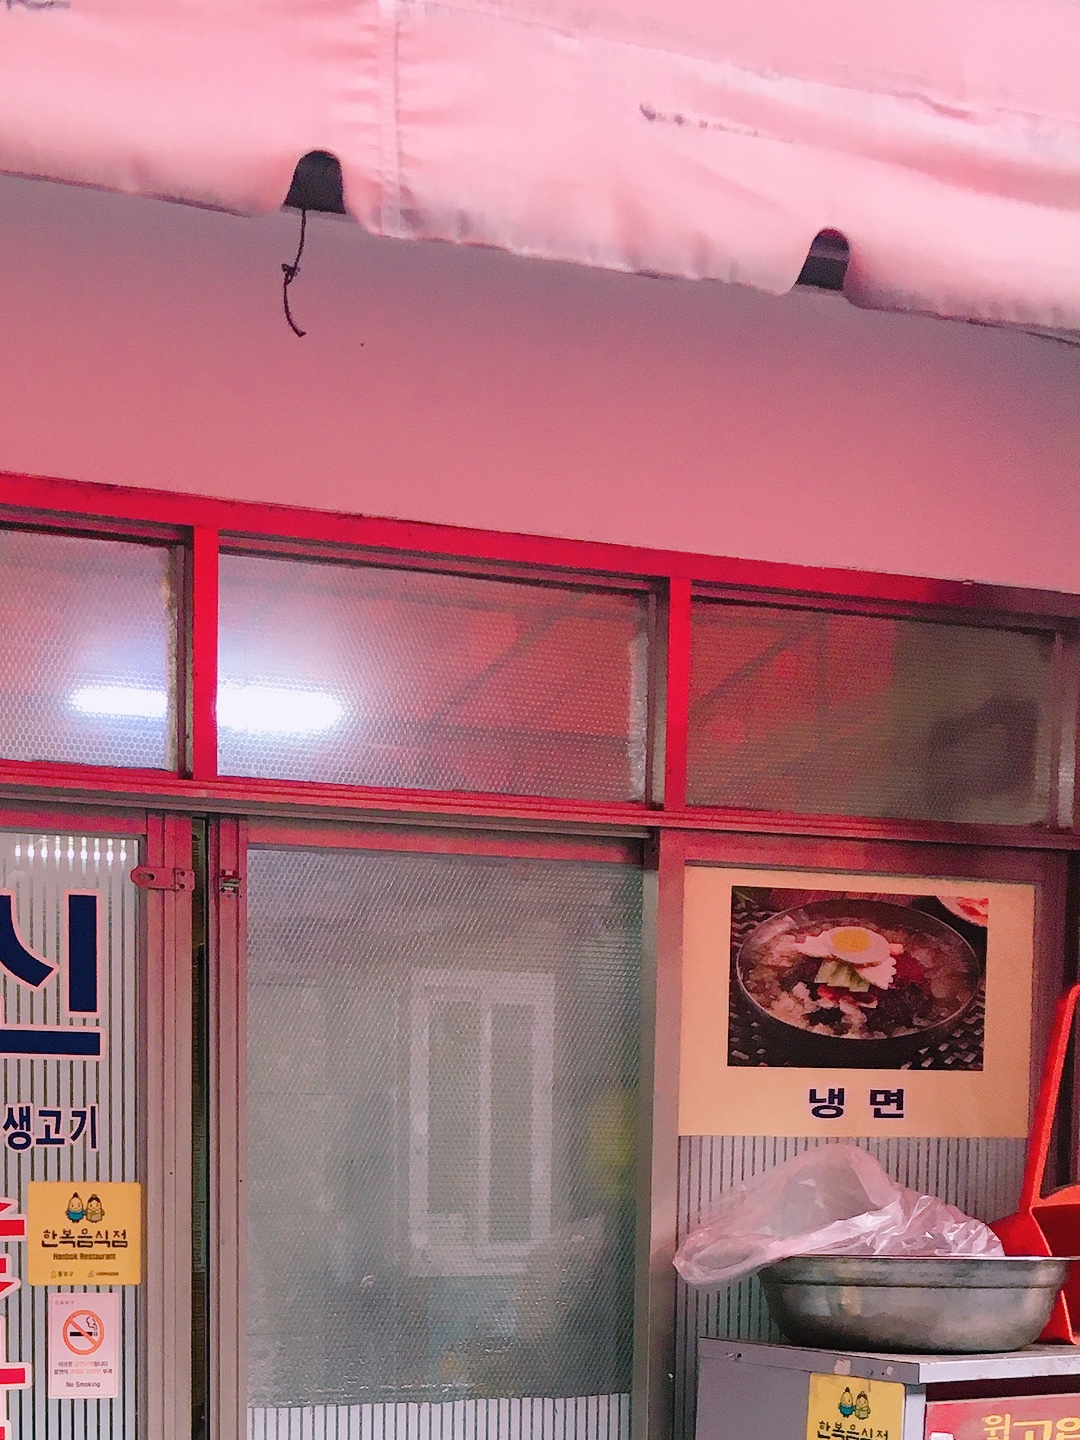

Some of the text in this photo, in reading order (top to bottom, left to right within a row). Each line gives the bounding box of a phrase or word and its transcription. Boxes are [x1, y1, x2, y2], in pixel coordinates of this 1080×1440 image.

[809, 1087, 905, 1119] 냉면
[41, 1228, 128, 1248] 한복음식점
[80, 1252, 117, 1261] Restaurant
